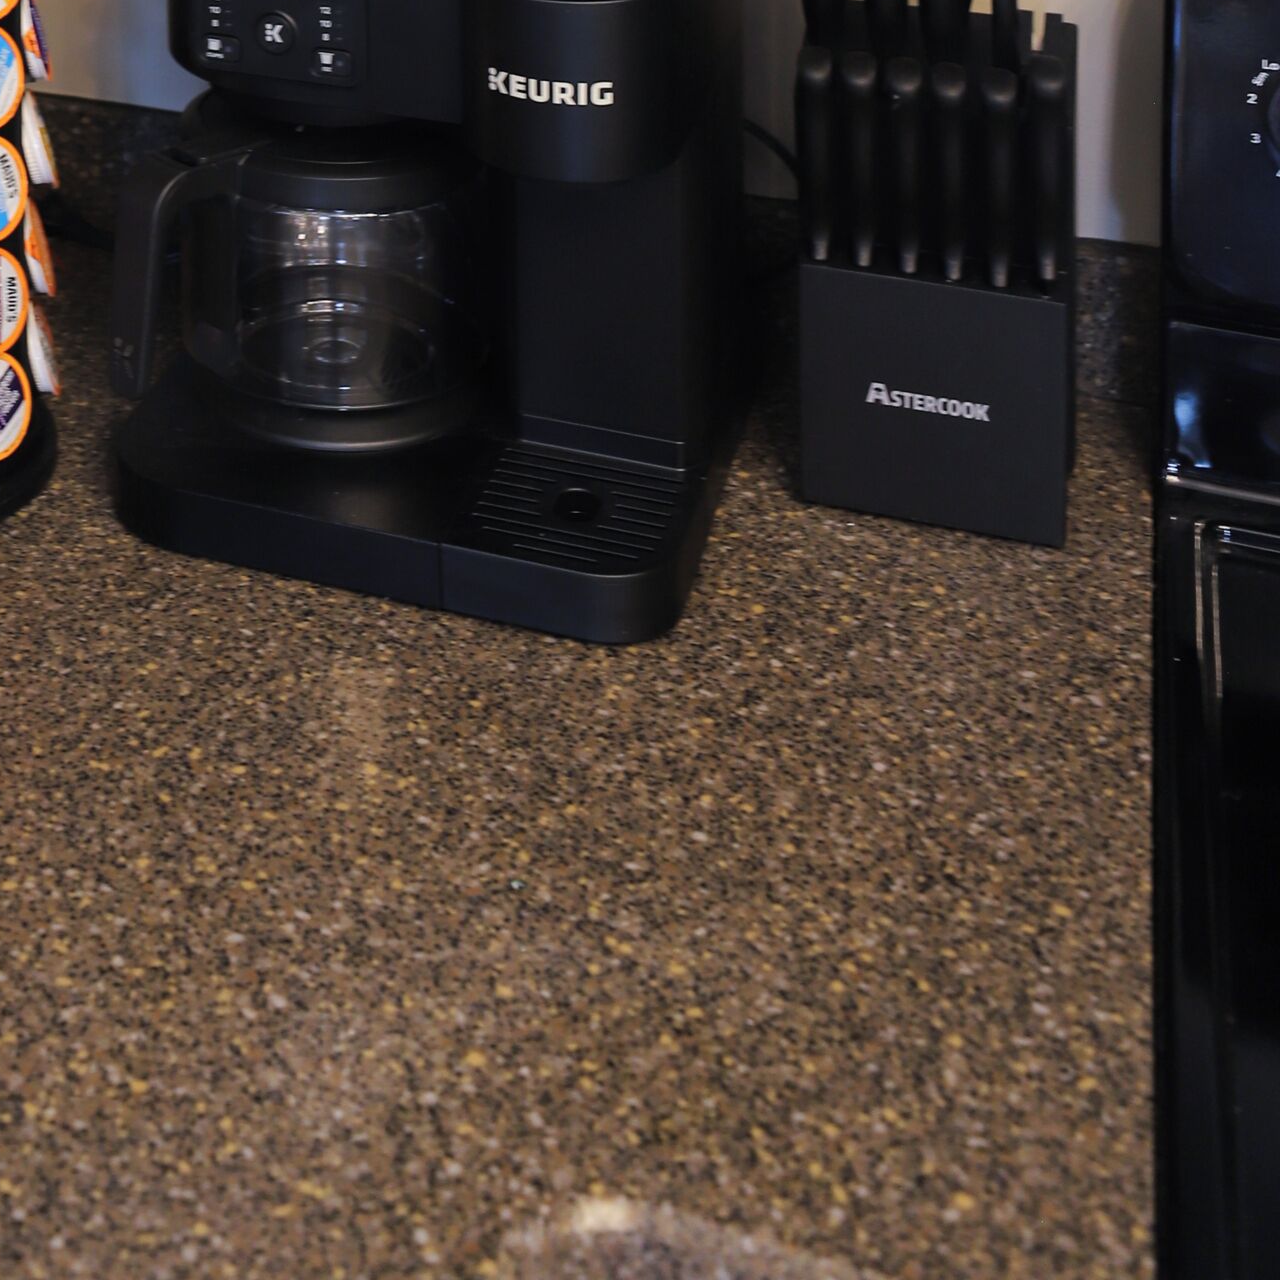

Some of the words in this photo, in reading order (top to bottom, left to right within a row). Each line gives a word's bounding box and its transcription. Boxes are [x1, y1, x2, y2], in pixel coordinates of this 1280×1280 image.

[488, 67, 614, 107] KEURIG
[1246, 93, 1259, 105] 2
[1249, 132, 1262, 144] 3
[7, 276, 17, 323] MAUD'S
[865, 381, 990, 422] ASTERCOOK
